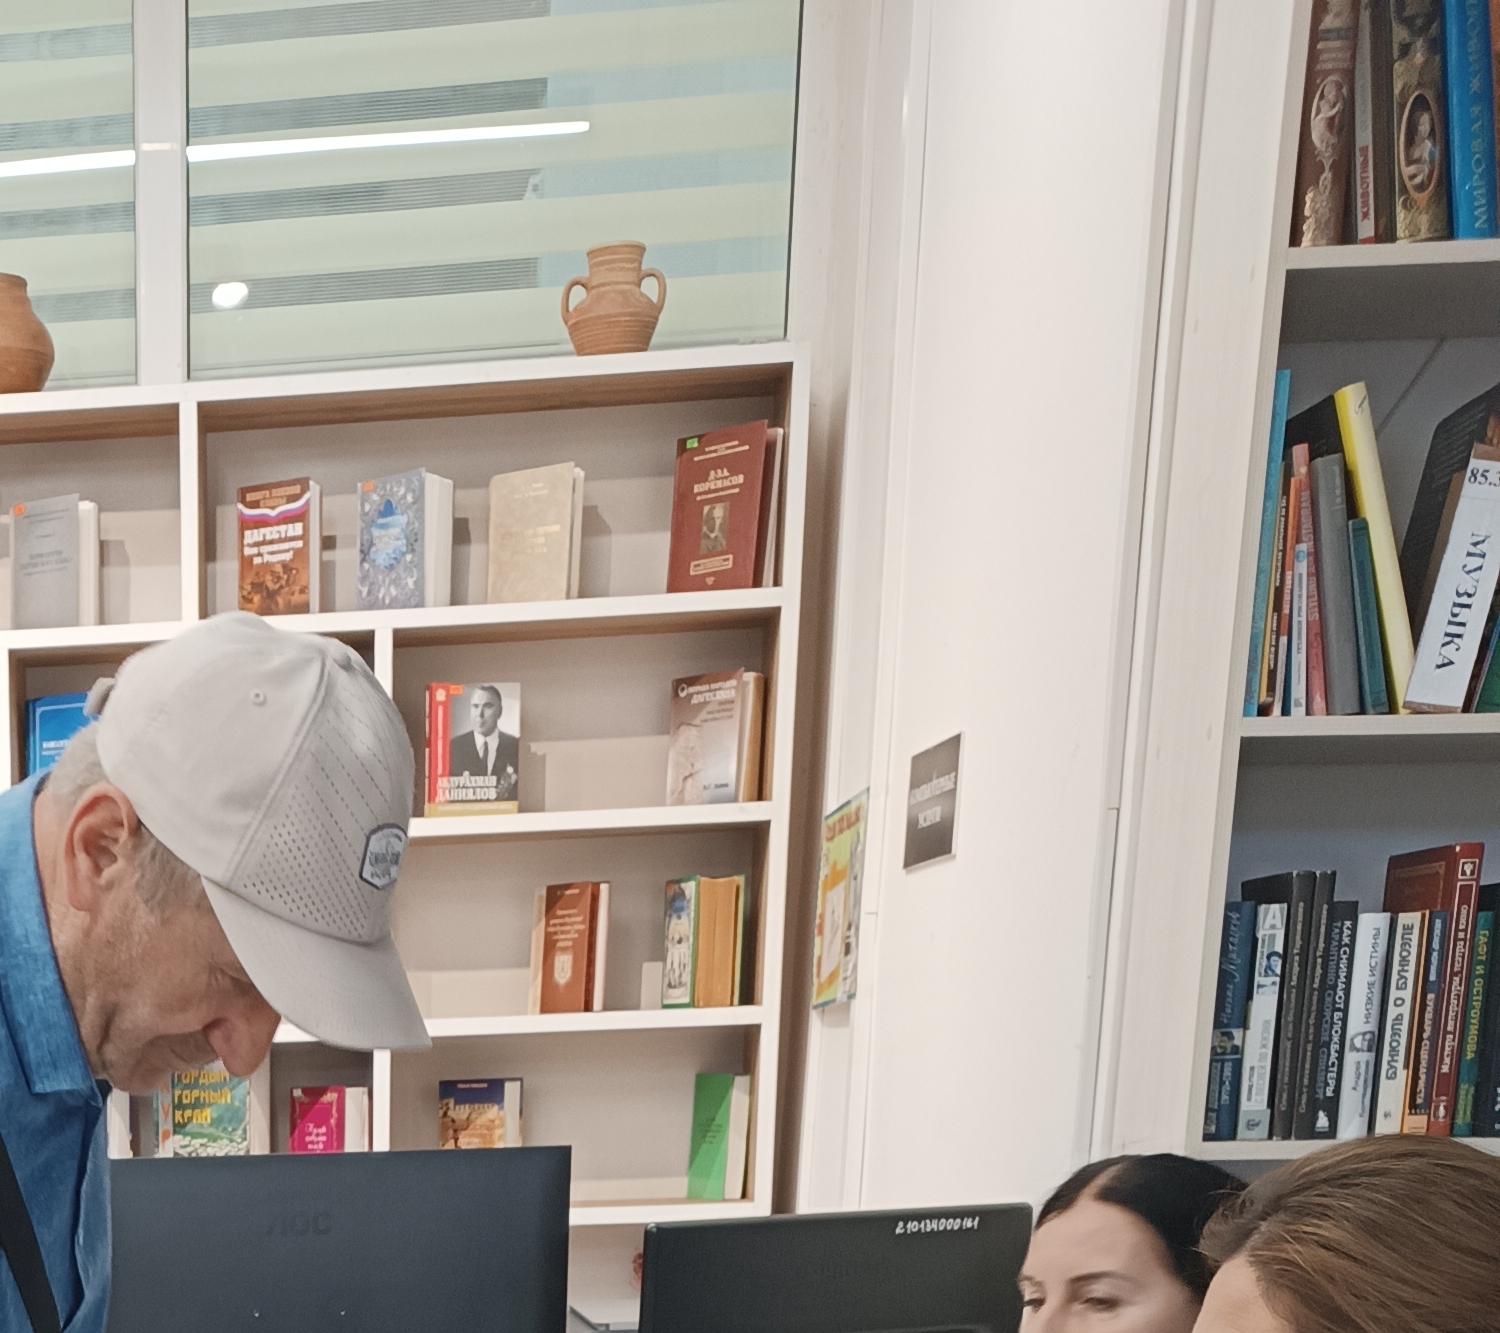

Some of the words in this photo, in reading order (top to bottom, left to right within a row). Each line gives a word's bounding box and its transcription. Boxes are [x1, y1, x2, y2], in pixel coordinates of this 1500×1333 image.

[1359, 145, 1373, 222] ЖИВОТНЫЕ
[1470, 105, 1488, 229] МИРОВАЯ
[244, 522, 303, 545] ДАГЕСТАН
[1434, 532, 1492, 671] МУЗЫКА
[1341, 920, 1352, 944] КАК
[1368, 927, 1381, 977] ИСТИНЫ
[1476, 930, 1489, 961] ГАФТ
[1334, 947, 1350, 1008] СНИМАЮТ
[1395, 923, 1414, 991] БУНЮЭЛЕ
[1476, 965, 1485, 974] И
[1363, 979, 1376, 1024] НИЗКИЕ
[1393, 997, 1405, 1007] О
[1422, 993, 1436, 1039] БУКВАРЬ
[1465, 978, 1484, 1059] ОСТРОУМОВА
[1326, 1011, 1343, 1097] БЛОКБАСТЕРЫ
[1385, 1013, 1404, 1080] БУНЮЭЛЬ
[1441, 1035, 1454, 1074] Мастера
[175, 1068, 229, 1085] ГОРДЫЙ
[1415, 1041, 1431, 1104] СЦЕНАРИСТА
[175, 1088, 231, 1104] ГОРНЫЙ
[175, 1107, 211, 1125] КРАЙ
